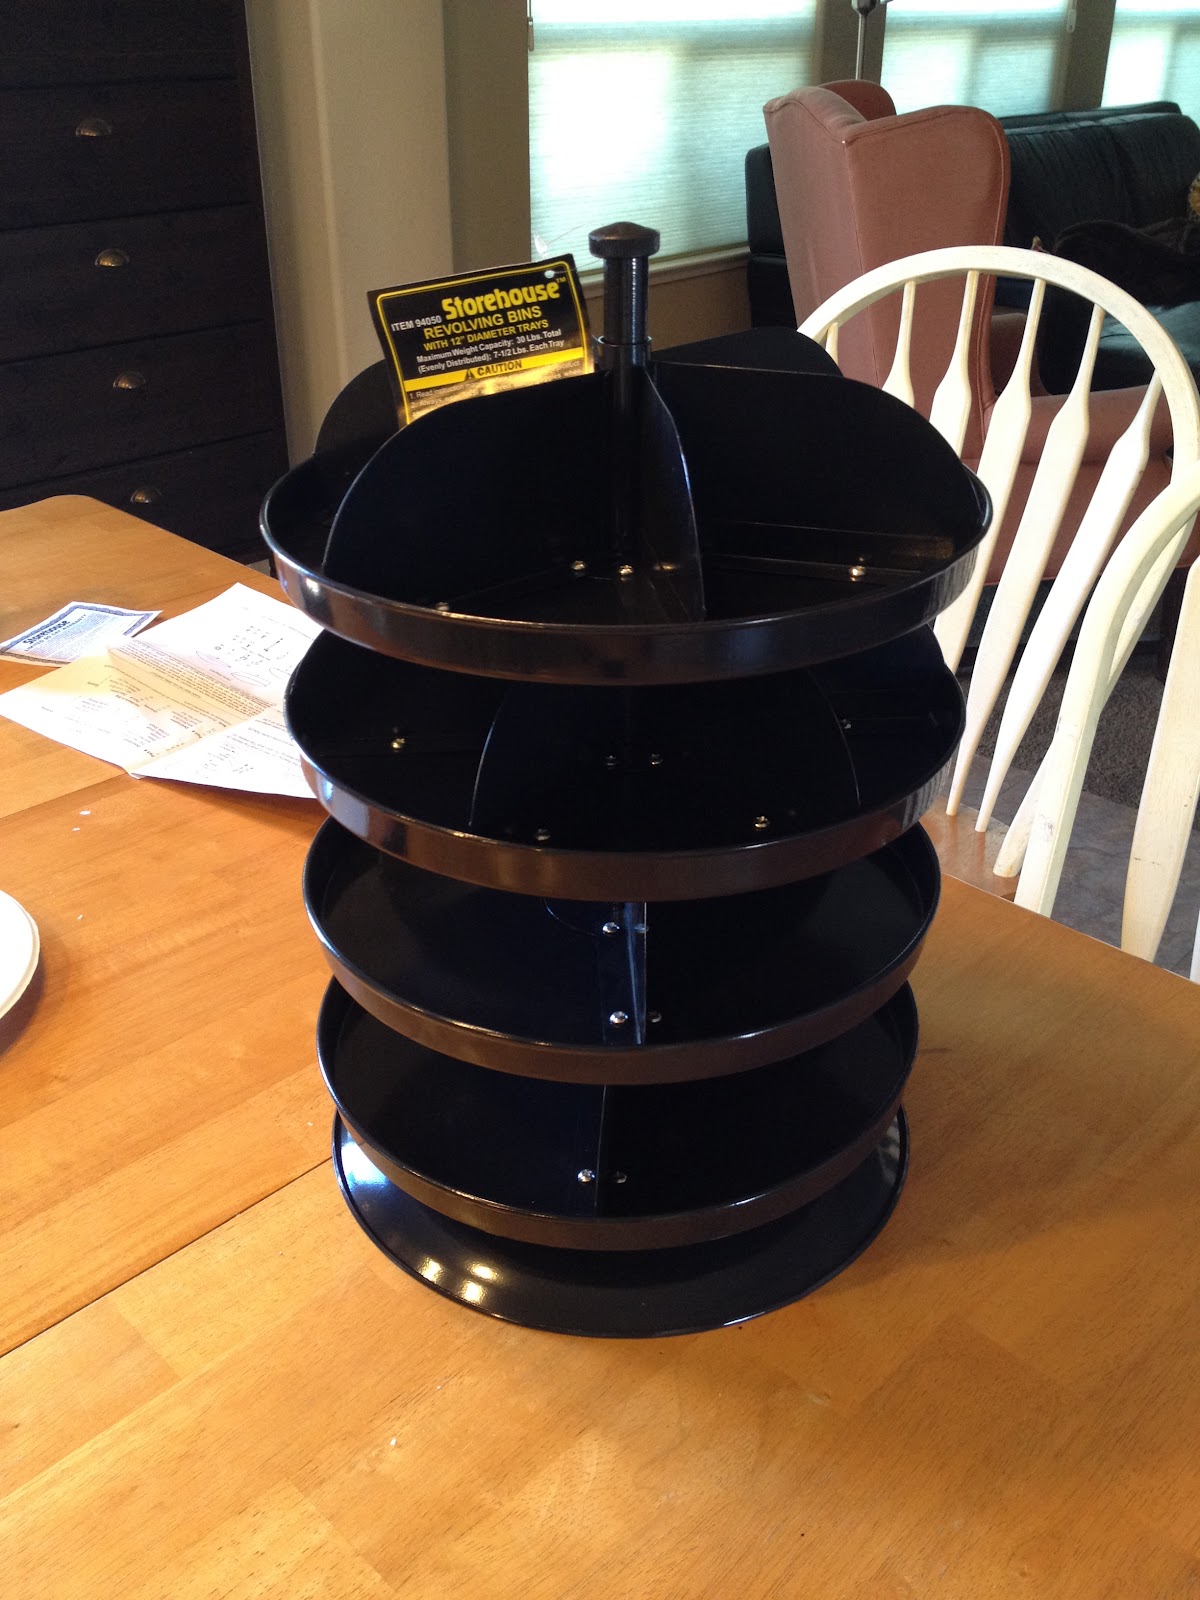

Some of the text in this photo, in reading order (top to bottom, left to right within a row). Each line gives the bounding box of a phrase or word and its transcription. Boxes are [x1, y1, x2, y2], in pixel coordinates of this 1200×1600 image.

[391, 315, 441, 332] ITEM 94050
[423, 306, 542, 339] REVOLVING BINS
[424, 339, 448, 351] WITH
[467, 327, 516, 343] DIAMETER
[517, 320, 548, 333] TRAYS
[416, 329, 561, 363] Maximum Weight Capacity: 30 Lbs. Total
[418, 362, 445, 374] (Evenly
[494, 349, 512, 359] 7-1/2
[513, 346, 528, 355] Lbs.
[529, 342, 547, 352] Each
[548, 339, 564, 350] Tray
[477, 360, 522, 376] CAUTION
[416, 390, 433, 398] Read
[23, 620, 70, 645] Storehouse
